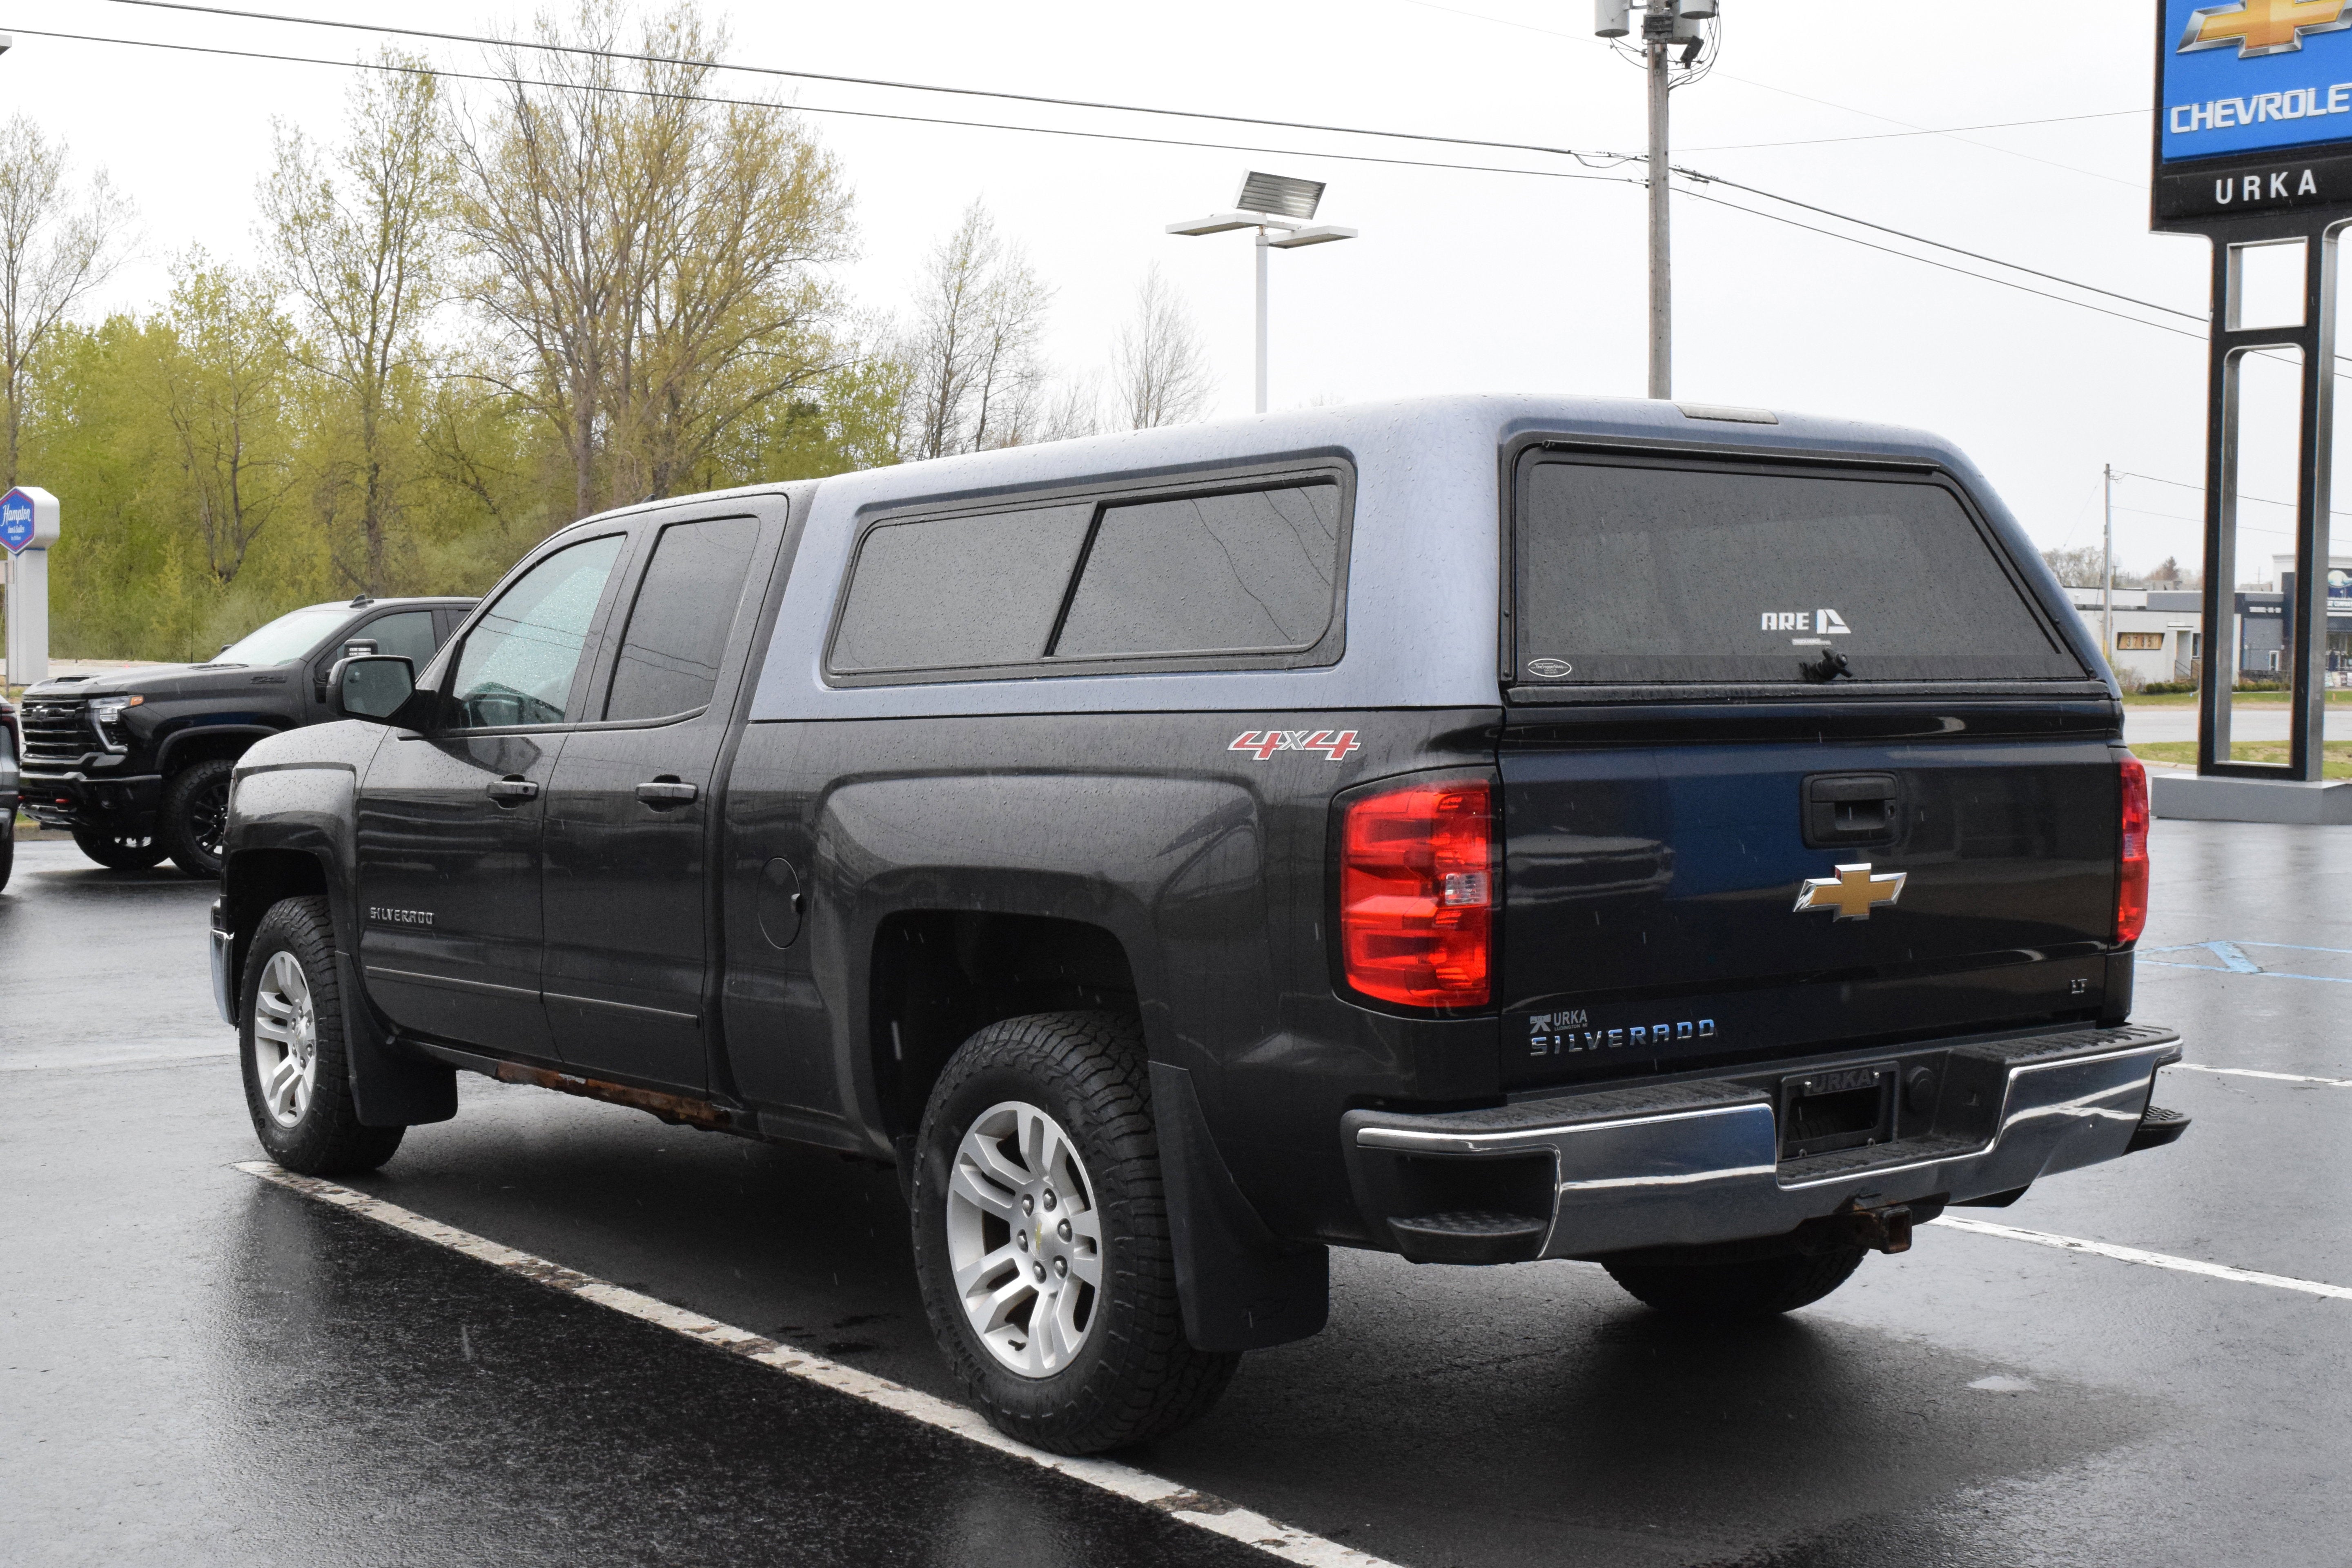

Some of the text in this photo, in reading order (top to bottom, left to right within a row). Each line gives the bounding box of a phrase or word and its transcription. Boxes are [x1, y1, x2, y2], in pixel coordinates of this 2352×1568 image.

[2170, 82, 2352, 133] CHEVROLE
[2216, 169, 2317, 204] URKA
[0, 503, 31, 526] Hampton
[1762, 612, 1809, 630] ARE
[370, 907, 434, 924] SILVERADO
[2071, 979, 2087, 994] LT
[1554, 1009, 1588, 1026] URKA
[1530, 1019, 1715, 1056] SILVERADO
[1812, 1069, 1871, 1093] URKA
